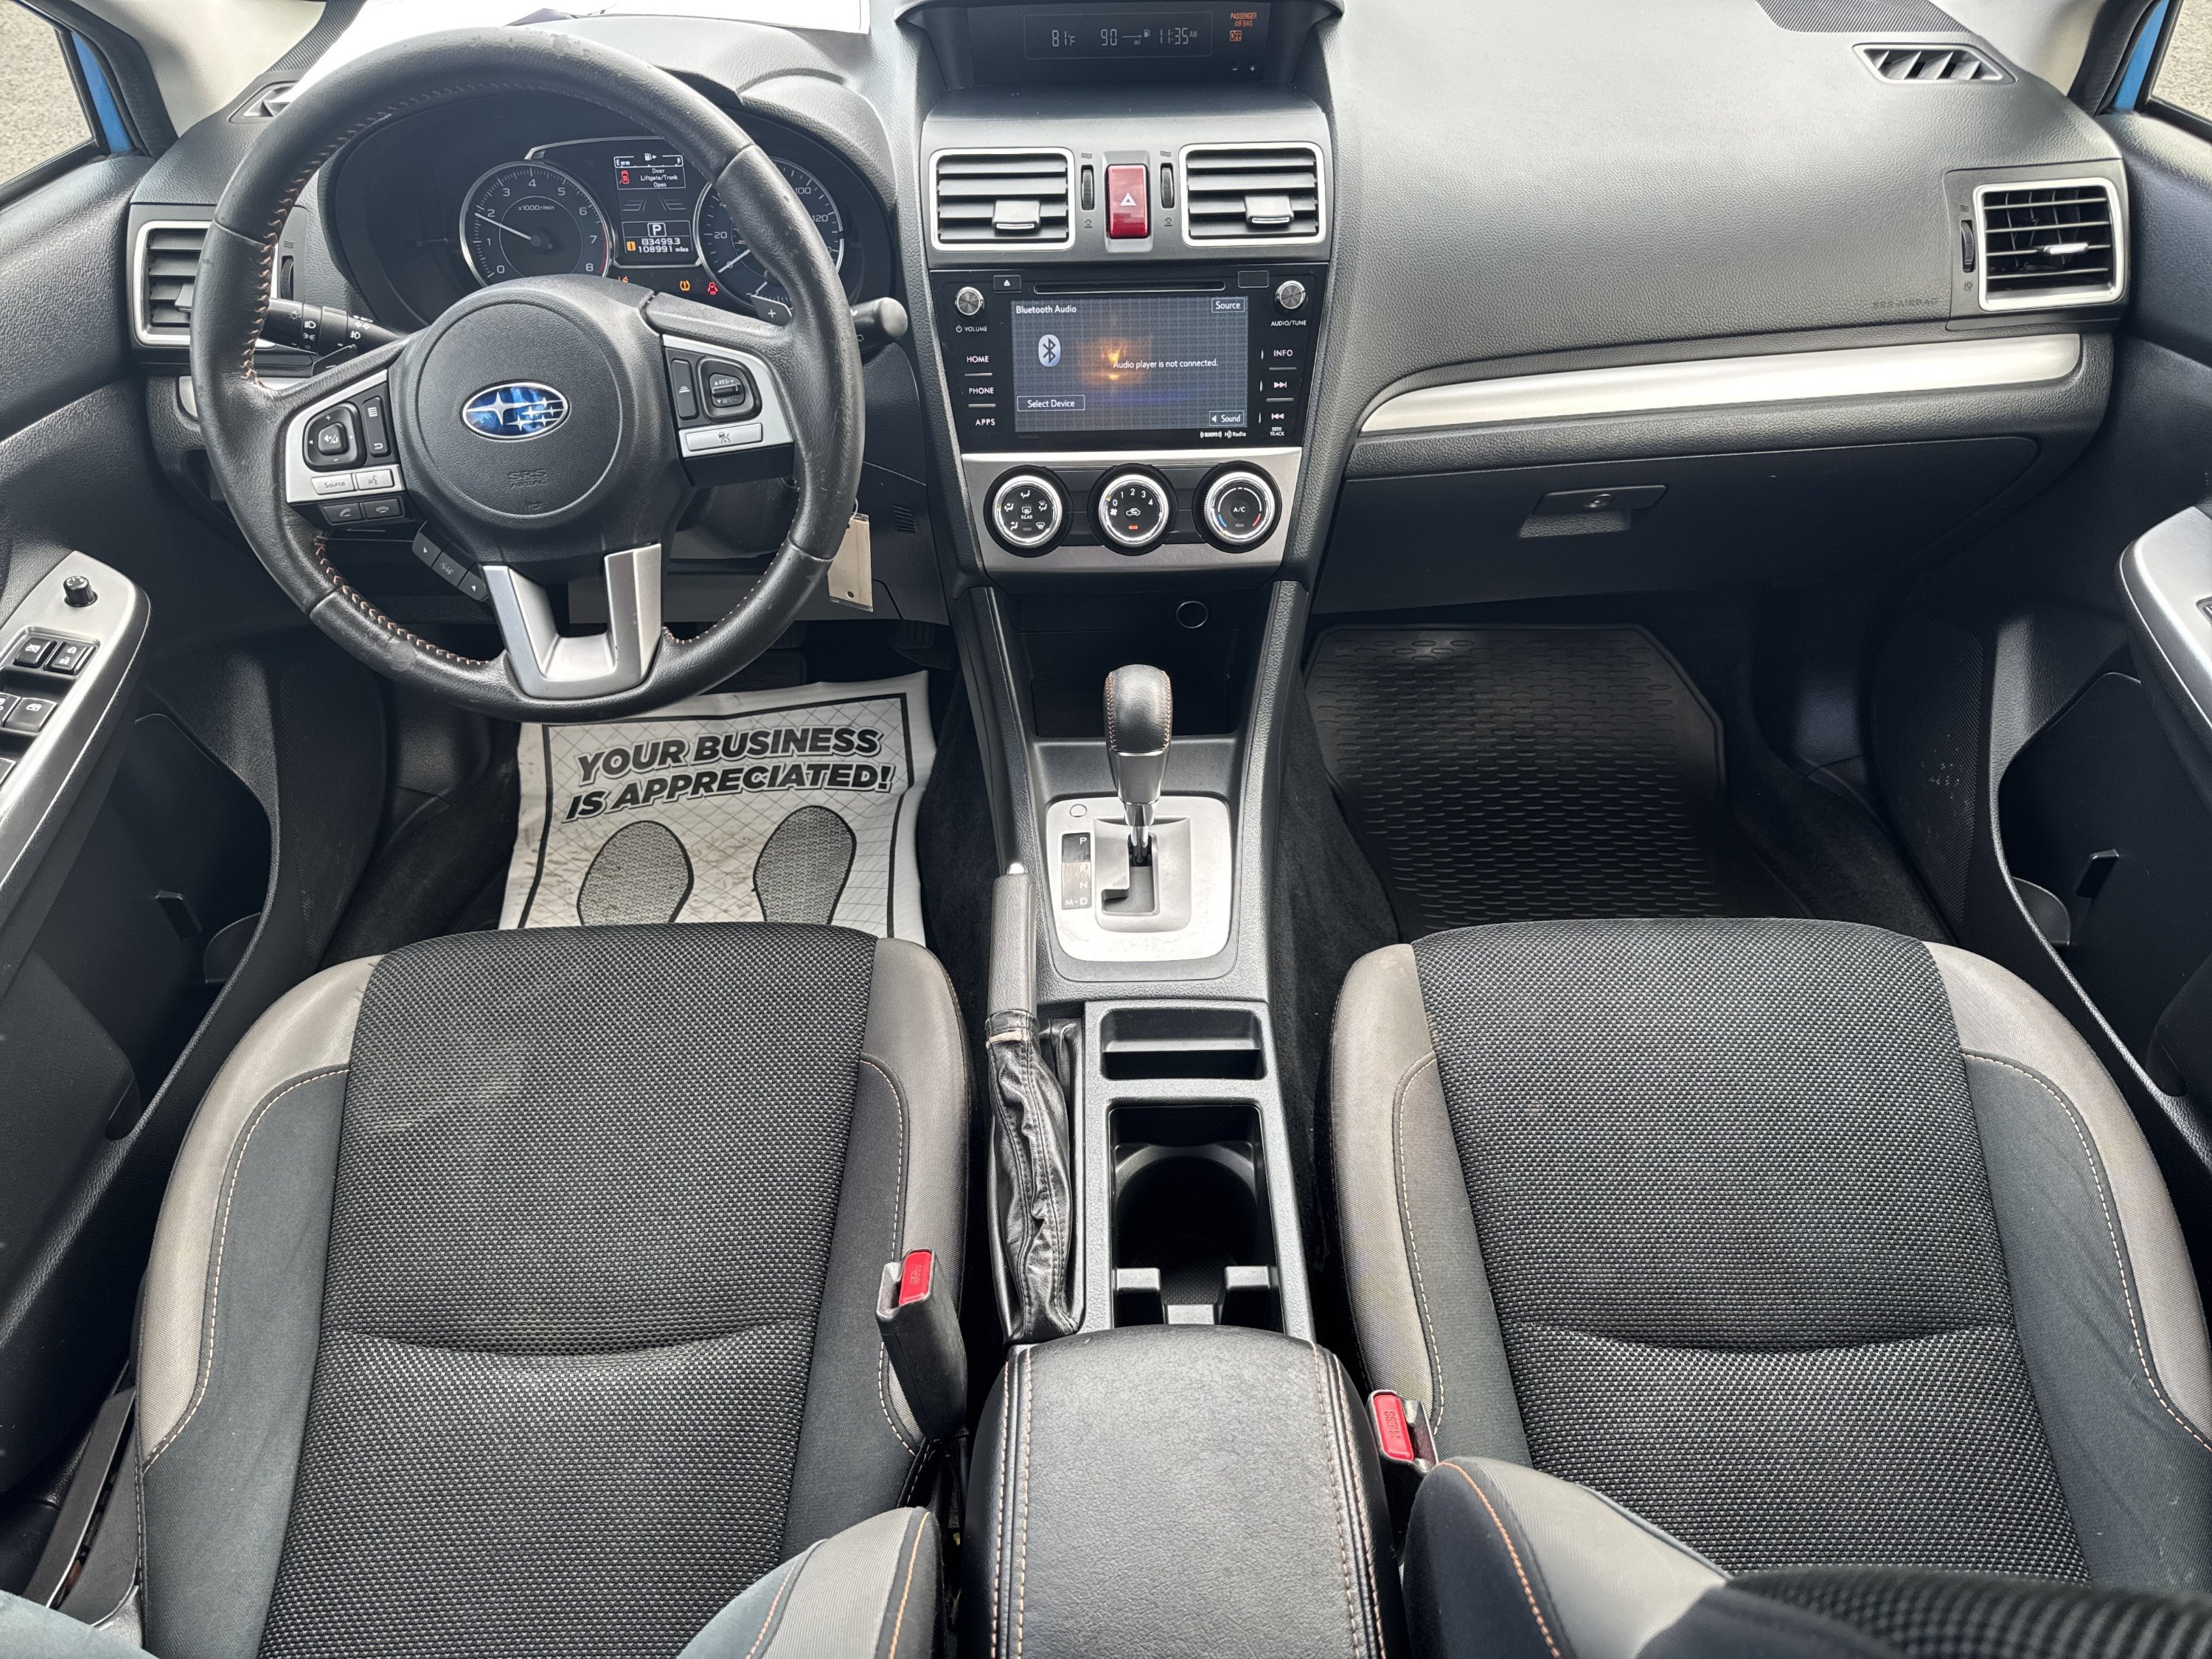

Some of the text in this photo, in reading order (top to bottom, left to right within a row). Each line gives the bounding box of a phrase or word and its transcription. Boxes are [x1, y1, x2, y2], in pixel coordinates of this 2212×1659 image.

[1230, 12, 1257, 20] PASSENGER
[1101, 29, 1117, 46] 90
[1160, 27, 1189, 44] 11:35
[1231, 31, 1241, 41] OFF
[529, 179, 537, 187] 4
[503, 188, 510, 197] 3
[558, 187, 566, 196] 5
[487, 209, 495, 218] 2
[579, 207, 587, 215] 6
[652, 224, 661, 235] P
[487, 238, 491, 246] 1
[590, 235, 597, 244] 7
[497, 265, 505, 274] 0
[585, 263, 594, 271] 8
[1015, 305, 1077, 314] Bluetooth Audio
[1215, 301, 1241, 310] Source
[1135, 361, 1157, 370] player
[1158, 360, 1164, 368] is
[1165, 360, 1178, 368] not
[1180, 359, 1219, 368] connected.
[1051, 400, 1075, 408] Device
[576, 727, 880, 784] YOUR BUSINESS
[565, 764, 893, 821] IS APPRECIATED!
[1079, 837, 1088, 845] P
[1079, 864, 1087, 872] R
[1079, 881, 1088, 889] N
